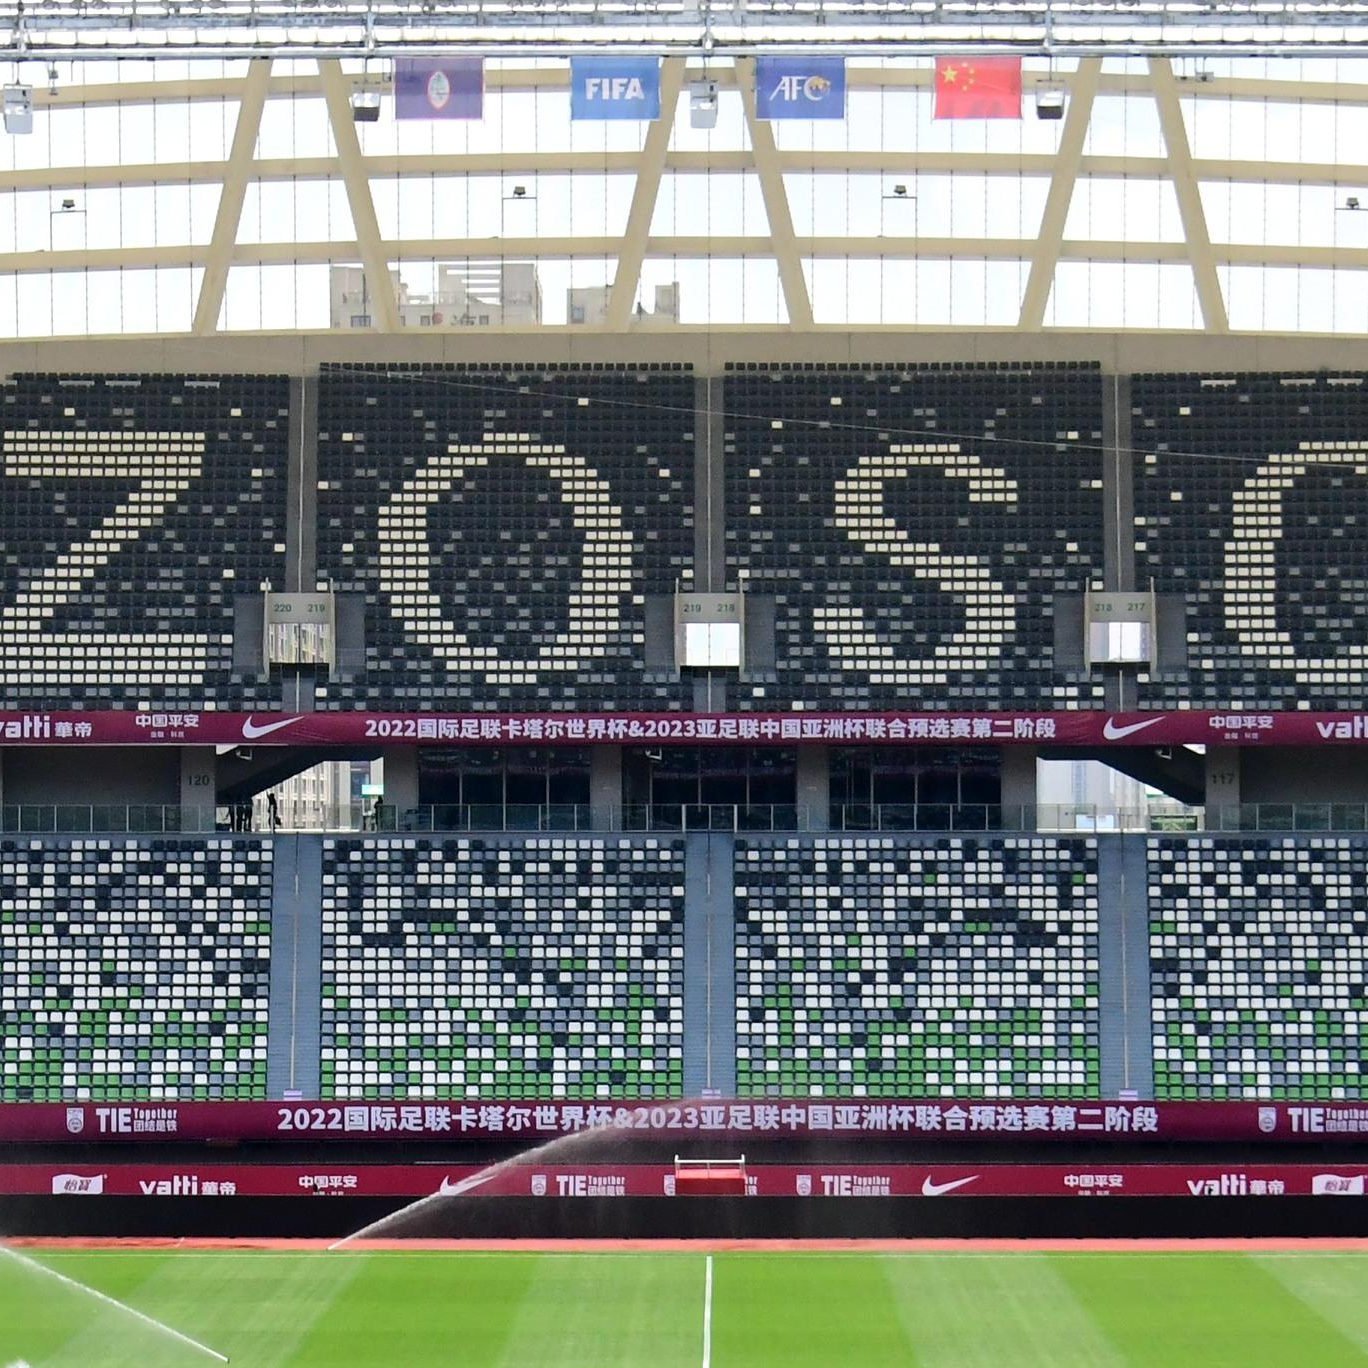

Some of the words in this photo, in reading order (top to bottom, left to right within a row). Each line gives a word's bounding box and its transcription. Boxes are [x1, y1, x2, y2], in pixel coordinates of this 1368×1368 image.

[586, 78, 644, 99] FIFA
[769, 75, 830, 101] AFC
[274, 603, 292, 613] 220
[135, 714, 199, 728] 中国平安
[365, 718, 1055, 739] 2022国际足联卡塔尔世界杯&2023亚足联中国亚洲杯联合预选赛第二阶段
[1208, 714, 1273, 729] 中国平安
[187, 774, 210, 786] 120
[95, 1107, 132, 1132] TIE
[133, 1107, 178, 1121] Together
[277, 1105, 1158, 1132] 2022国际足联卡塔尔世界杯&2023亚足联中国亚洲杯联合预选赛第二阶段
[1287, 1107, 1324, 1132] TIE
[139, 1174, 198, 1195] vatti
[298, 1175, 358, 1188] 中国平安
[556, 1175, 587, 1196] TIE
[588, 1175, 625, 1186] Together
[821, 1175, 851, 1196] TIE
[1064, 1174, 1123, 1188] 中国平安
[1186, 1173, 1246, 1195] vatti
